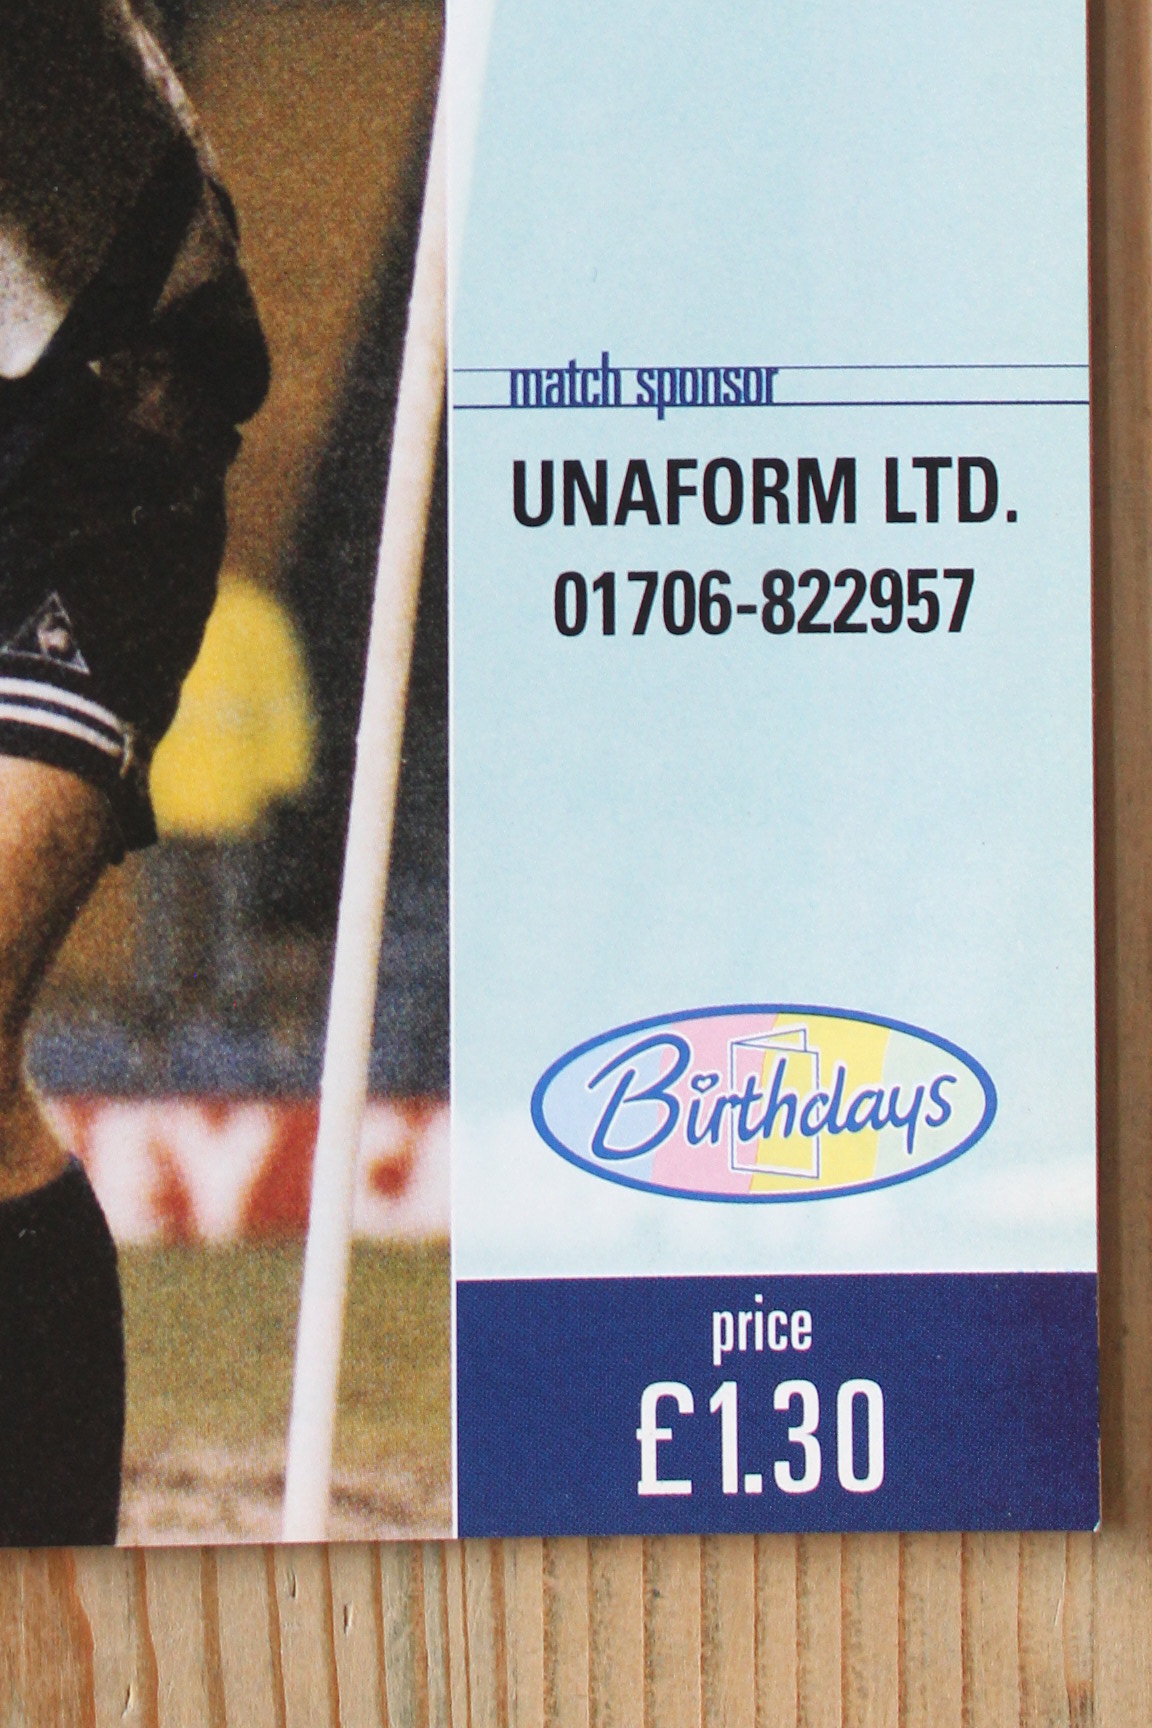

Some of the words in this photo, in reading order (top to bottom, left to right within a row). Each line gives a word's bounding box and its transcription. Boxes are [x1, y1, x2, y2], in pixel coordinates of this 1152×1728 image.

[509, 351, 622, 407] match
[636, 367, 779, 420] sponsor
[511, 457, 857, 527] UNAFORM
[884, 456, 1019, 524] LTD.
[553, 568, 975, 636] 01706-822957
[587, 1033, 958, 1161] Birthdays
[712, 1295, 812, 1365] price
[636, 1378, 886, 1496] £1.30
